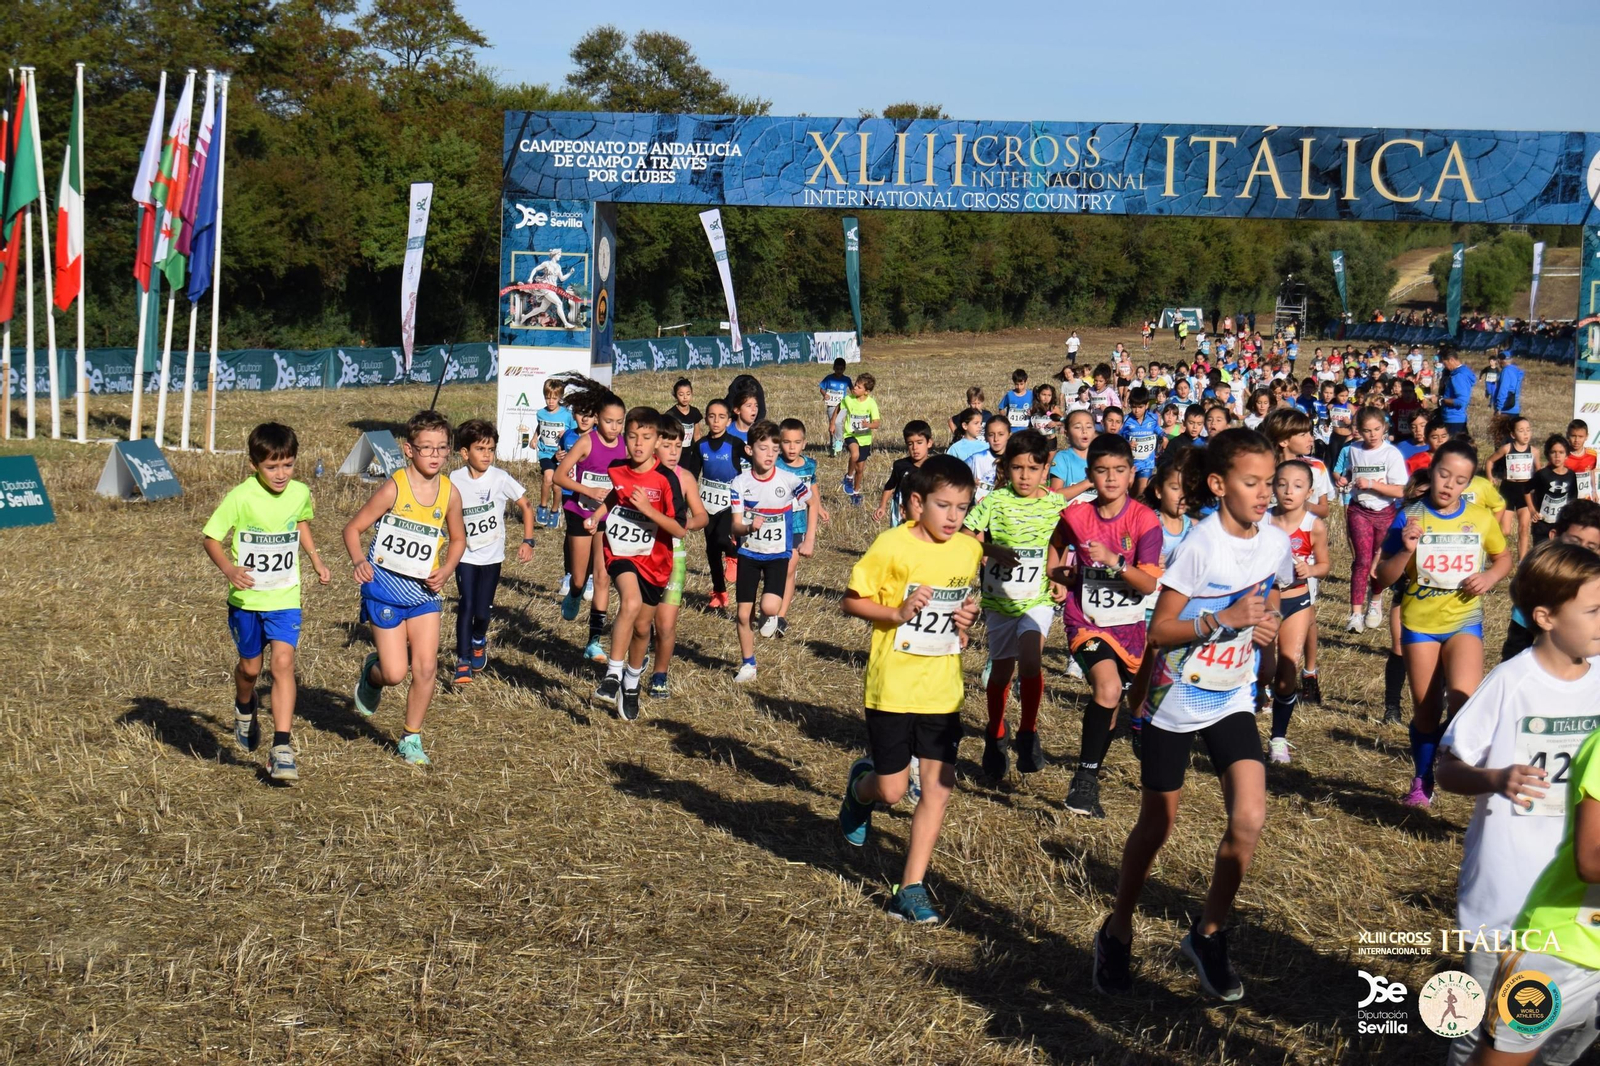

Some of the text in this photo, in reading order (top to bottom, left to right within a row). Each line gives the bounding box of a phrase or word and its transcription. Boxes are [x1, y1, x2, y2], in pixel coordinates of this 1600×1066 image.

[519, 139, 742, 157] CAMPEONATO DE ANDALUCÍA
[972, 135, 1101, 168] CROSS
[554, 154, 707, 170] DE CAMPO A TRAVÉS
[806, 131, 967, 187] XLIII
[1160, 125, 1482, 203] ITÁLICA
[588, 169, 676, 184] POR CLUBES
[972, 170, 1147, 191] INTERNACIONAL
[804, 189, 1115, 210] INTERNATIONAL CROSS COUNTRY
[550, 218, 583, 228] Sevilla
[628, 359, 647, 371] Sevilla
[700, 354, 713, 366] Sevilla
[296, 372, 321, 388] Sevilla
[358, 370, 382, 384] Sevilla
[459, 365, 479, 380] Sevilla
[104, 376, 133, 392] Sevilla
[236, 374, 261, 390] Sevilla
[153, 467, 174, 482] Sevilla
[2, 480, 38, 490] Diputación
[6, 490, 43, 507] Sevilla
[700, 490, 728, 507] 4115
[608, 523, 652, 544] 4256
[747, 528, 782, 541] 143
[381, 534, 432, 562] 4309
[243, 551, 293, 572] 4320
[1422, 554, 1474, 573] 4345
[989, 562, 1039, 583] 4317
[1553, 718, 1597, 732] ITÁLICA
[1527, 751, 1572, 784] 42
